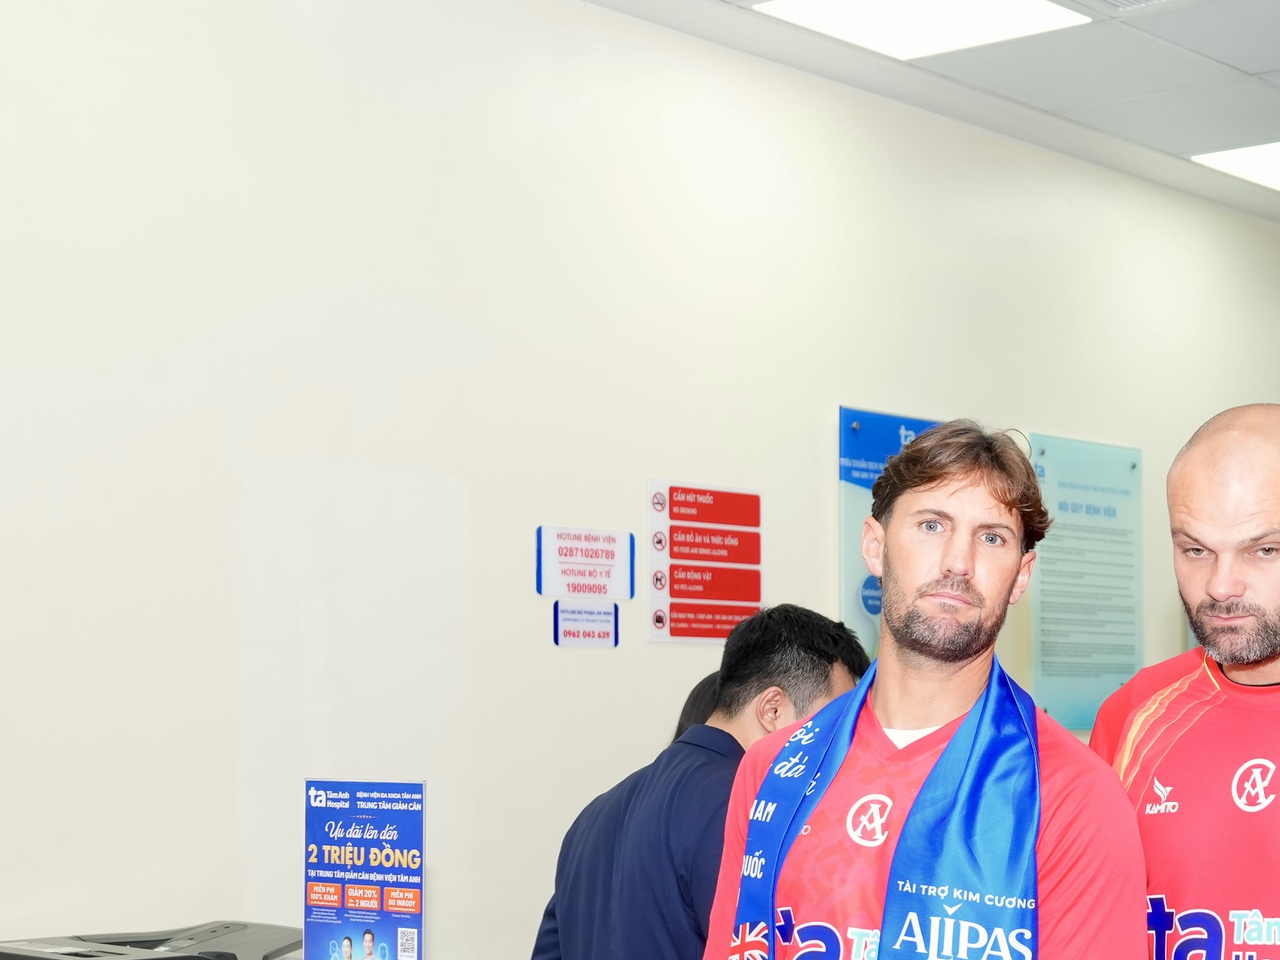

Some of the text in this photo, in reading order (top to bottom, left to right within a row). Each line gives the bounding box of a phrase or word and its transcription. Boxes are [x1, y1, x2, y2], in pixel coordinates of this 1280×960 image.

[557, 532, 617, 545] HOTLINE BỆNH VIỆN
[558, 546, 615, 560] 02871026789
[561, 568, 586, 578] HOTLINE
[588, 568, 598, 579] BỘ
[604, 568, 611, 579] TẾ
[566, 583, 608, 594] 19009095
[563, 629, 610, 639] 0962 043 639
[774, 751, 809, 778] đá
[308, 787, 326, 808] ta
[356, 801, 378, 809] TRUNG
[378, 801, 391, 810] TÂM
[1145, 801, 1179, 815] KAMITO
[363, 823, 379, 840] lên
[307, 841, 421, 869] 2 TRIỆU ĐỒNG
[740, 850, 765, 879] UỐC
[364, 889, 377, 898] 20%
[897, 880, 1036, 909] TÀI TRỢ KIM CƯƠNG
